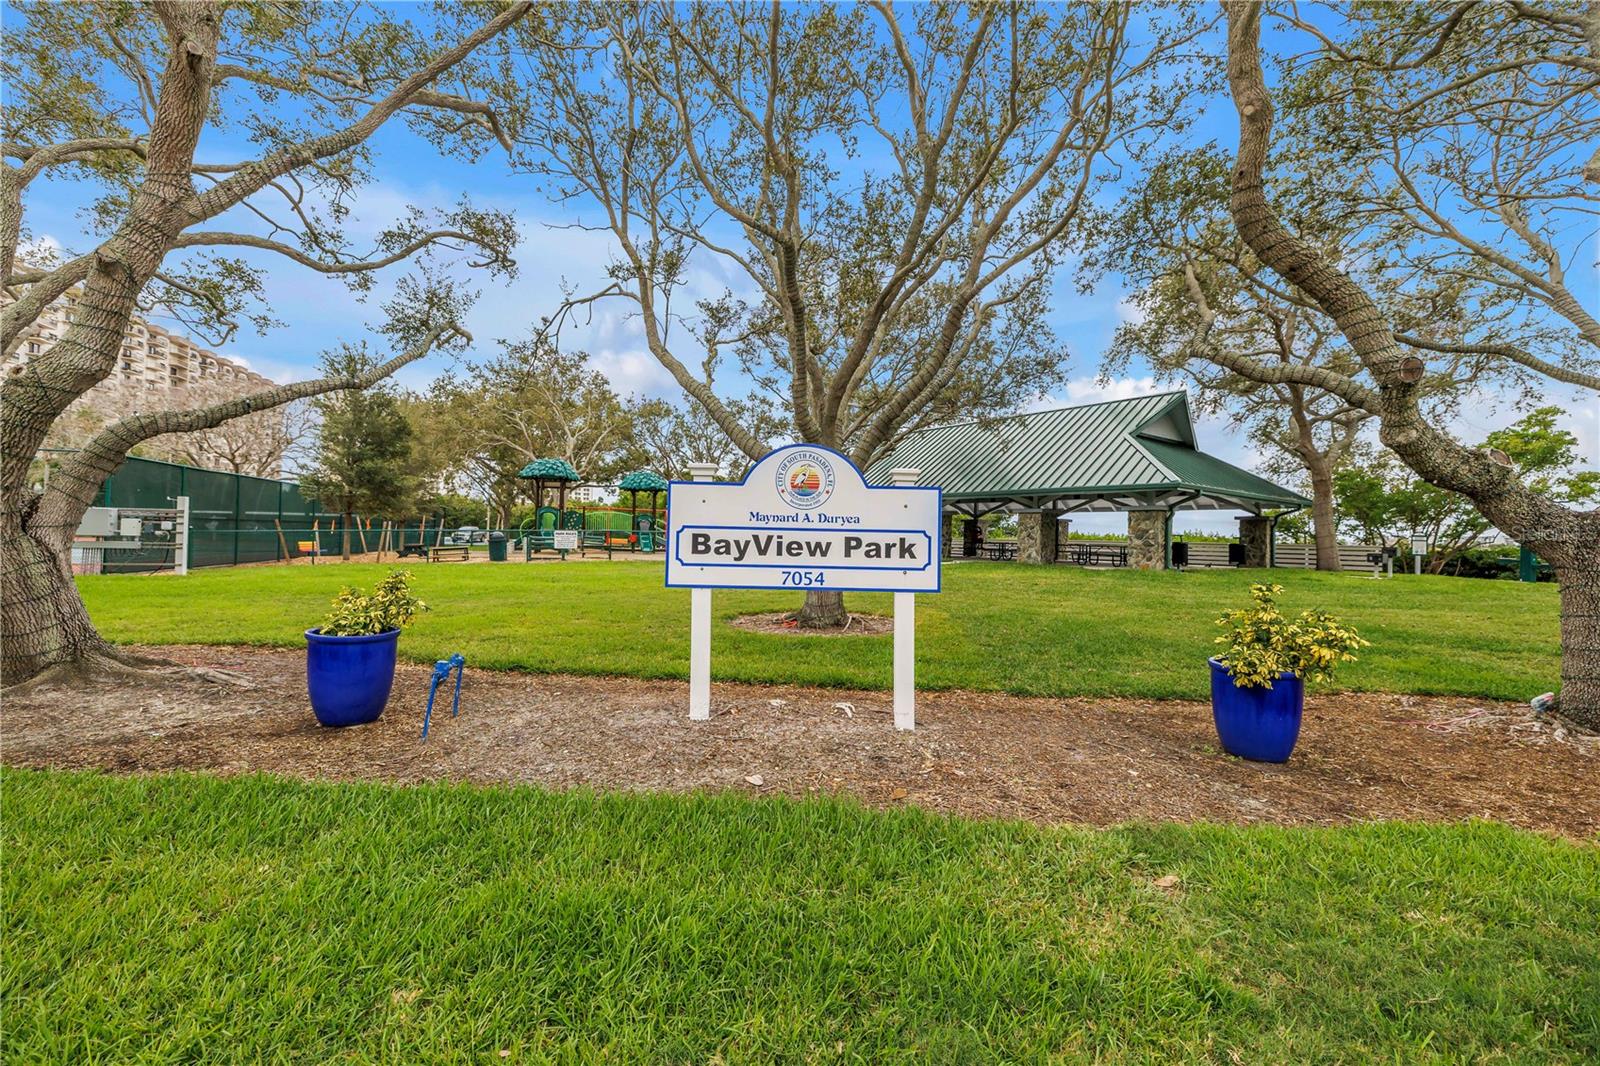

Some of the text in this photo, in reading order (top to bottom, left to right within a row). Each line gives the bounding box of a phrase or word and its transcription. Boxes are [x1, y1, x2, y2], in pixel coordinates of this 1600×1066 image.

[781, 463, 788, 472] OF
[787, 453, 808, 465] SOUTH
[748, 511, 860, 526] Maynard A. Duryea
[690, 533, 917, 562] BayView Park
[781, 571, 825, 586] 7054
